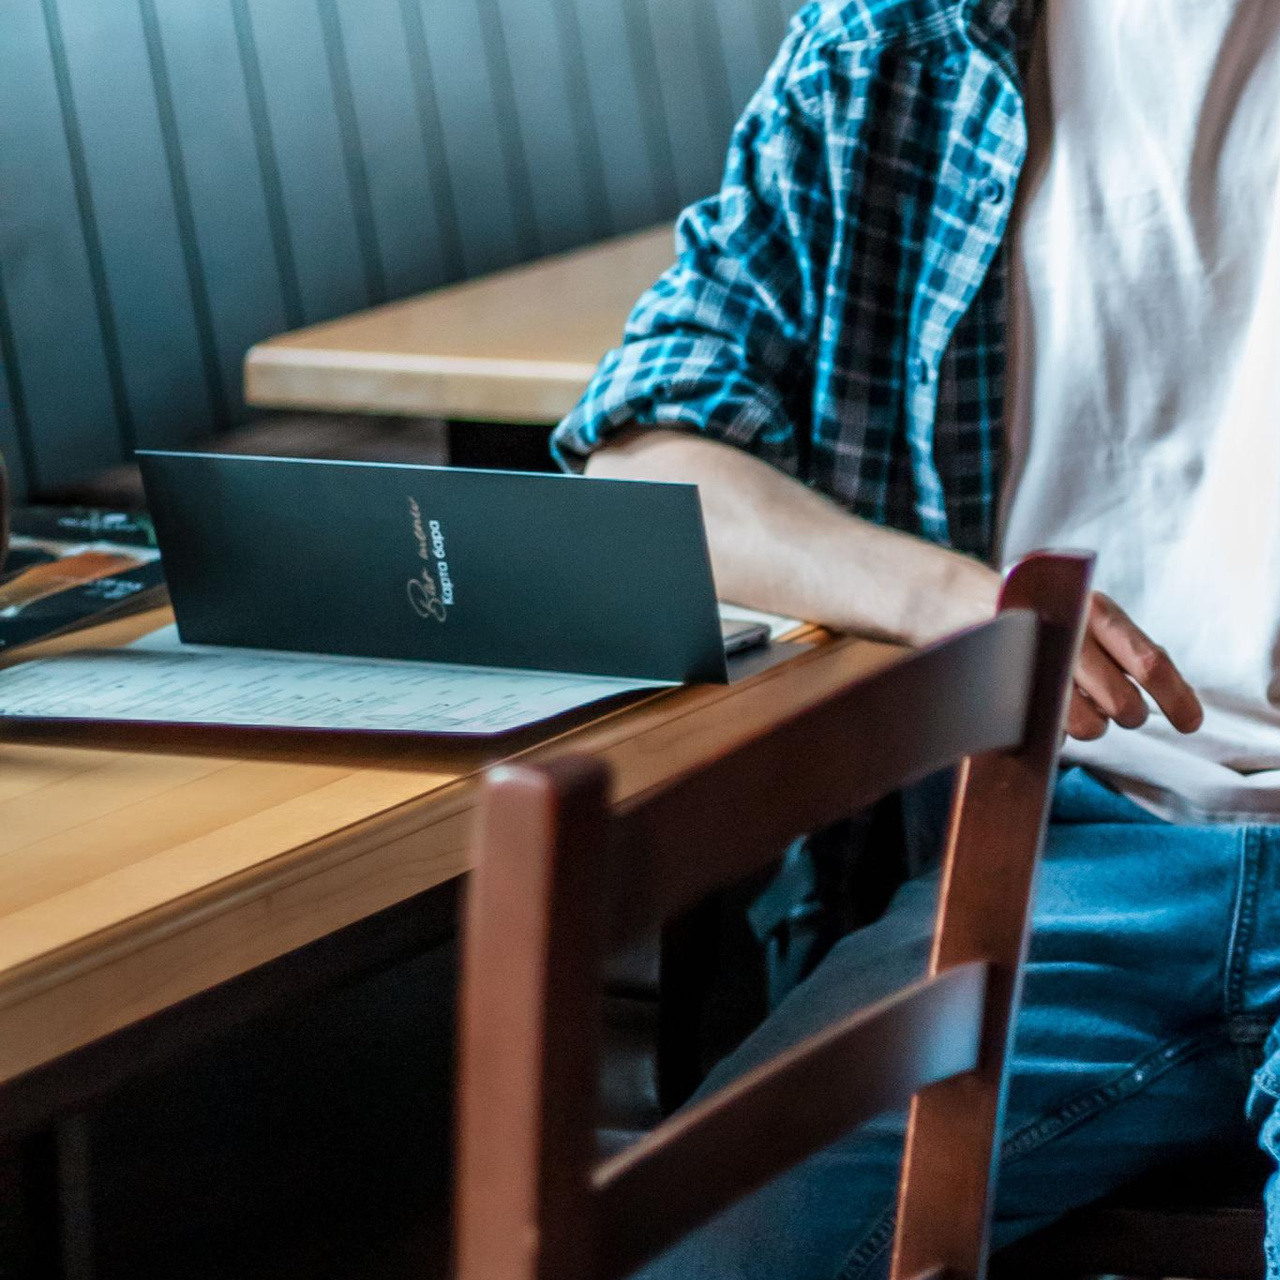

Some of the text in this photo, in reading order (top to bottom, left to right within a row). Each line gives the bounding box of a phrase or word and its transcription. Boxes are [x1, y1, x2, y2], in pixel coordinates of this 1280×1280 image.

[407, 496, 446, 622] Bar menu
[429, 520, 454, 605] Карта бара
